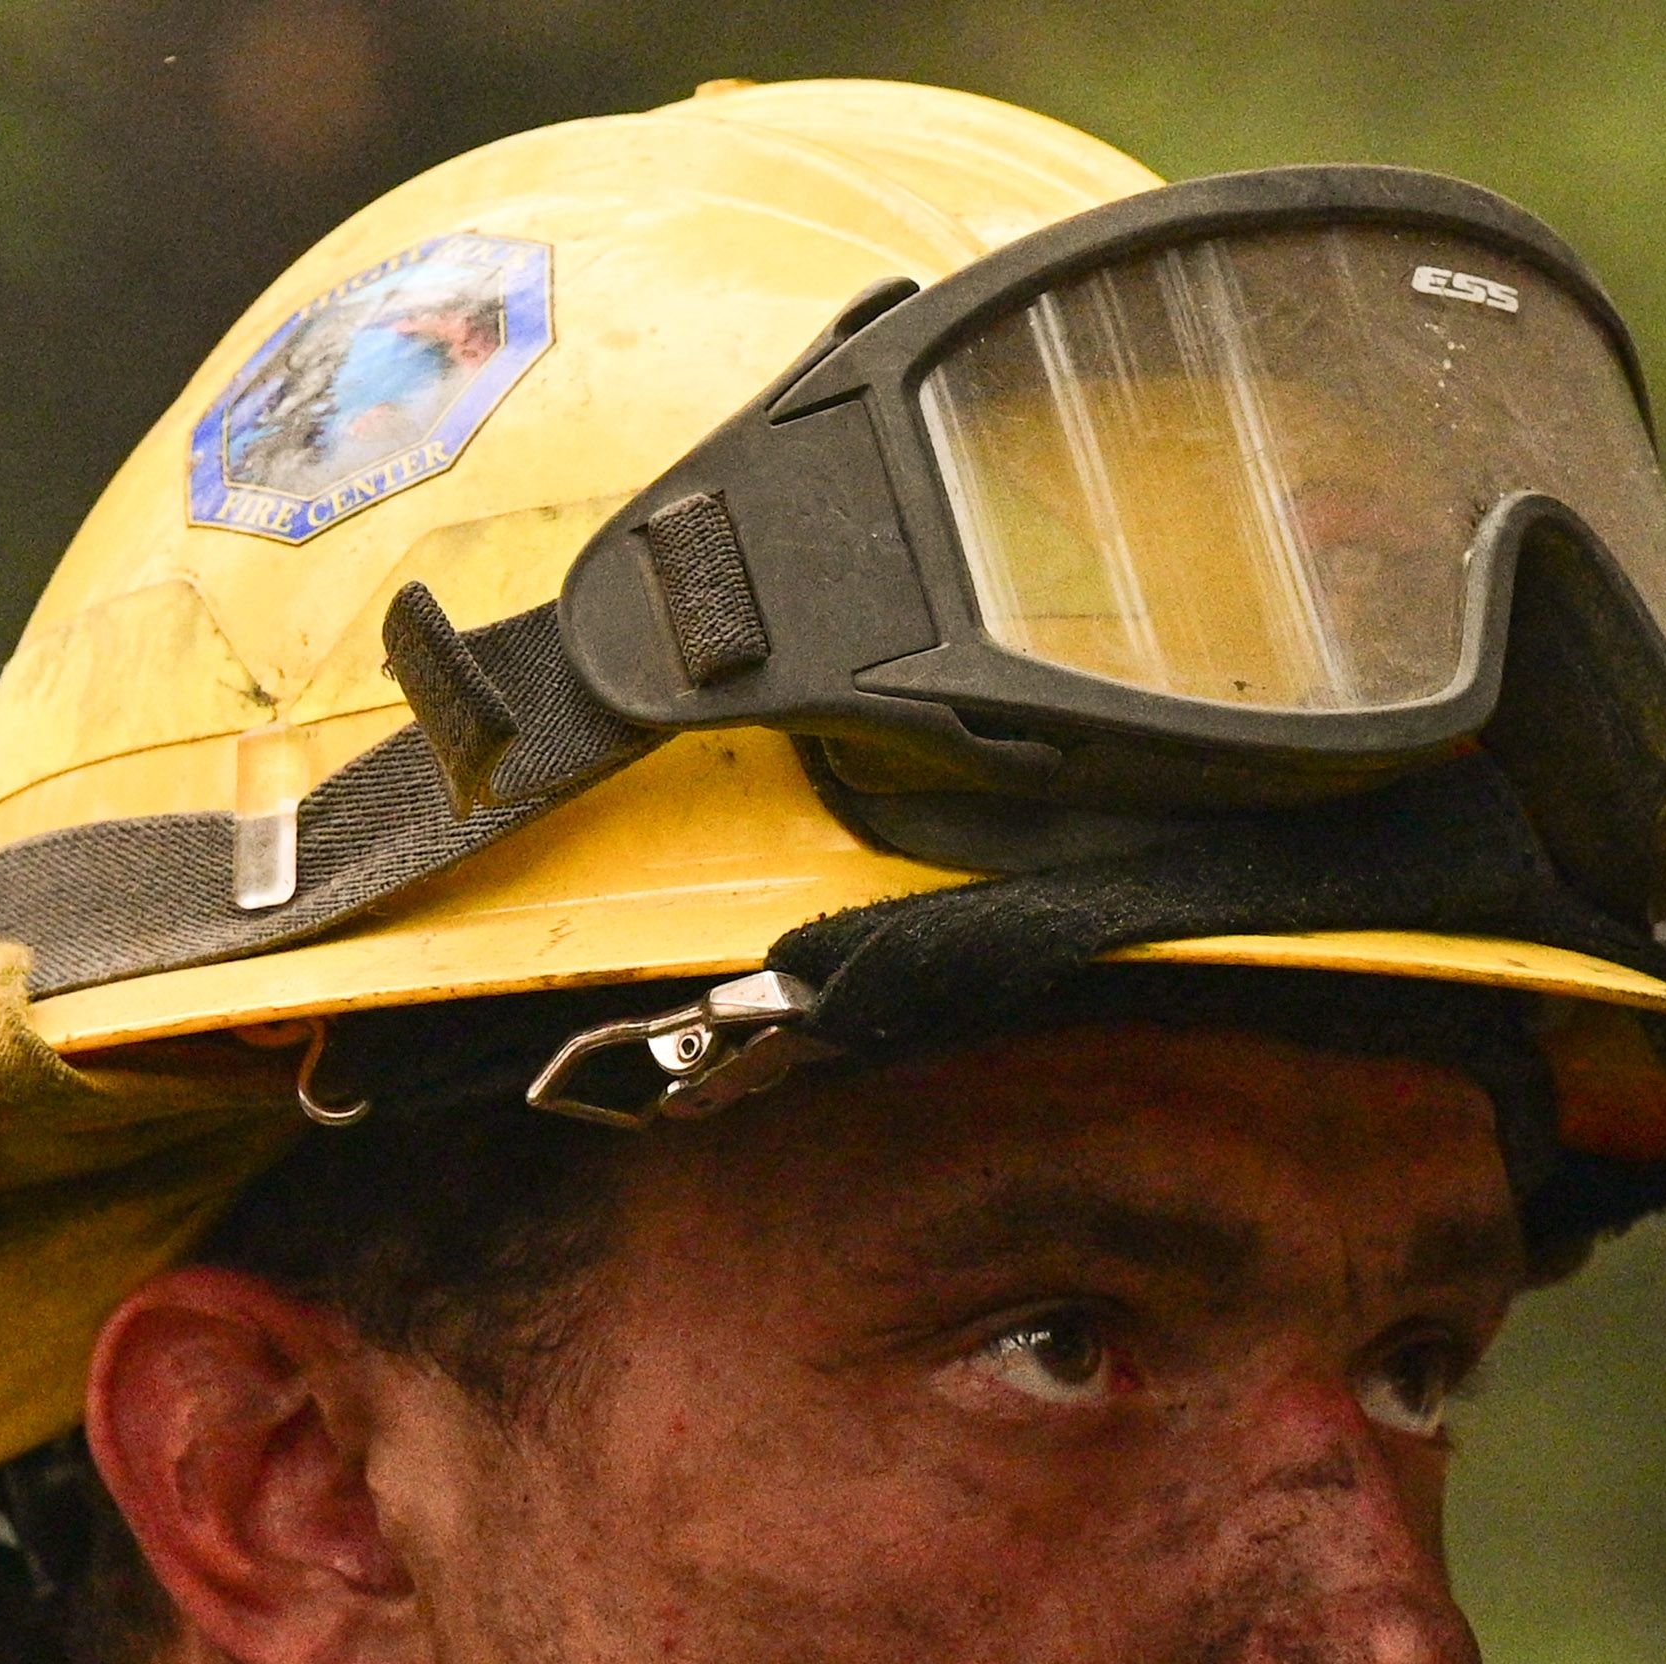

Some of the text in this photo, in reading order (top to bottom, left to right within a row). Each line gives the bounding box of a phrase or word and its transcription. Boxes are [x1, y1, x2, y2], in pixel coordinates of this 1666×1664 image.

[1411, 266, 1519, 313] ESS
[214, 440, 451, 534] FIRE CENTER
